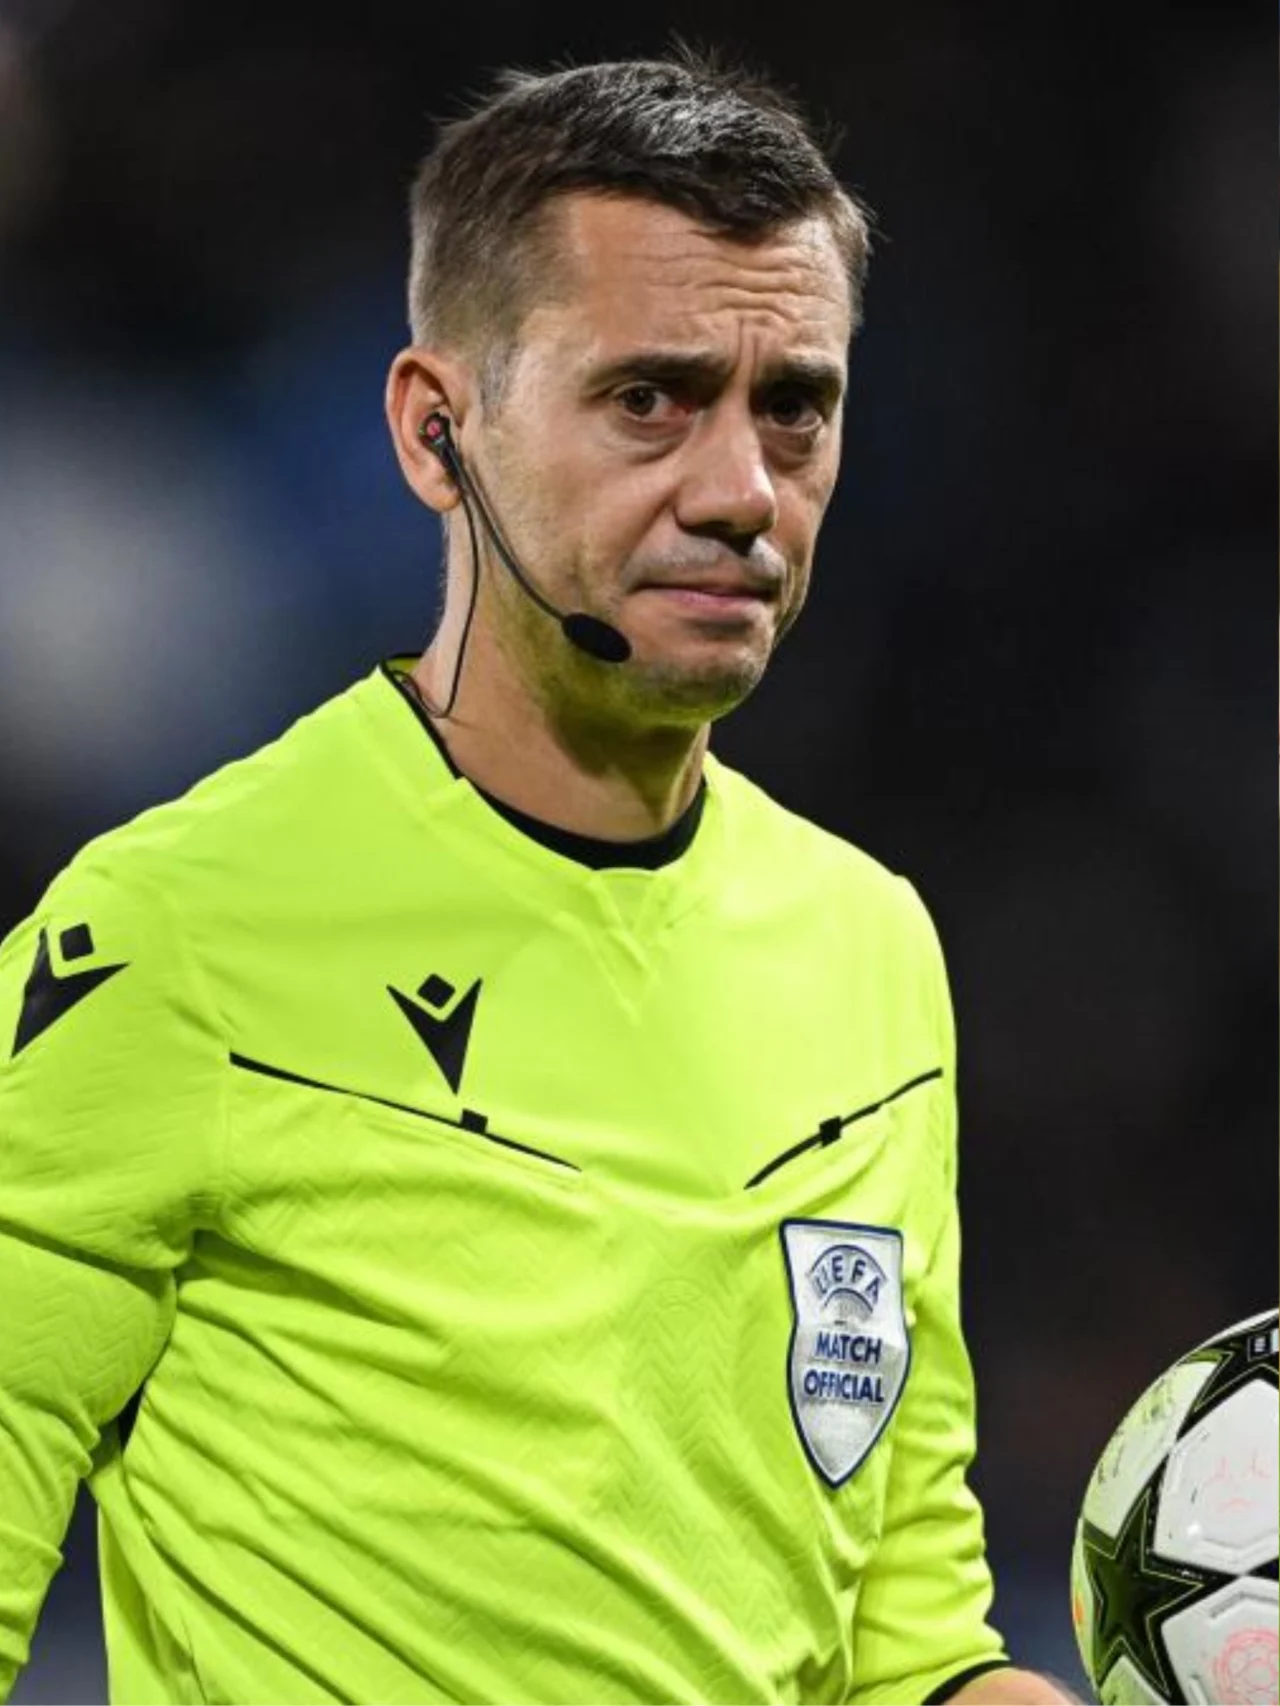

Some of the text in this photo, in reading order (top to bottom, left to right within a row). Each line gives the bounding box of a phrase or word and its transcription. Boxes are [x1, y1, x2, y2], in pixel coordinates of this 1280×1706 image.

[814, 1255, 880, 1305] UEFA
[814, 1331, 881, 1364] MATCH
[804, 1369, 884, 1403] OFFICIAL
